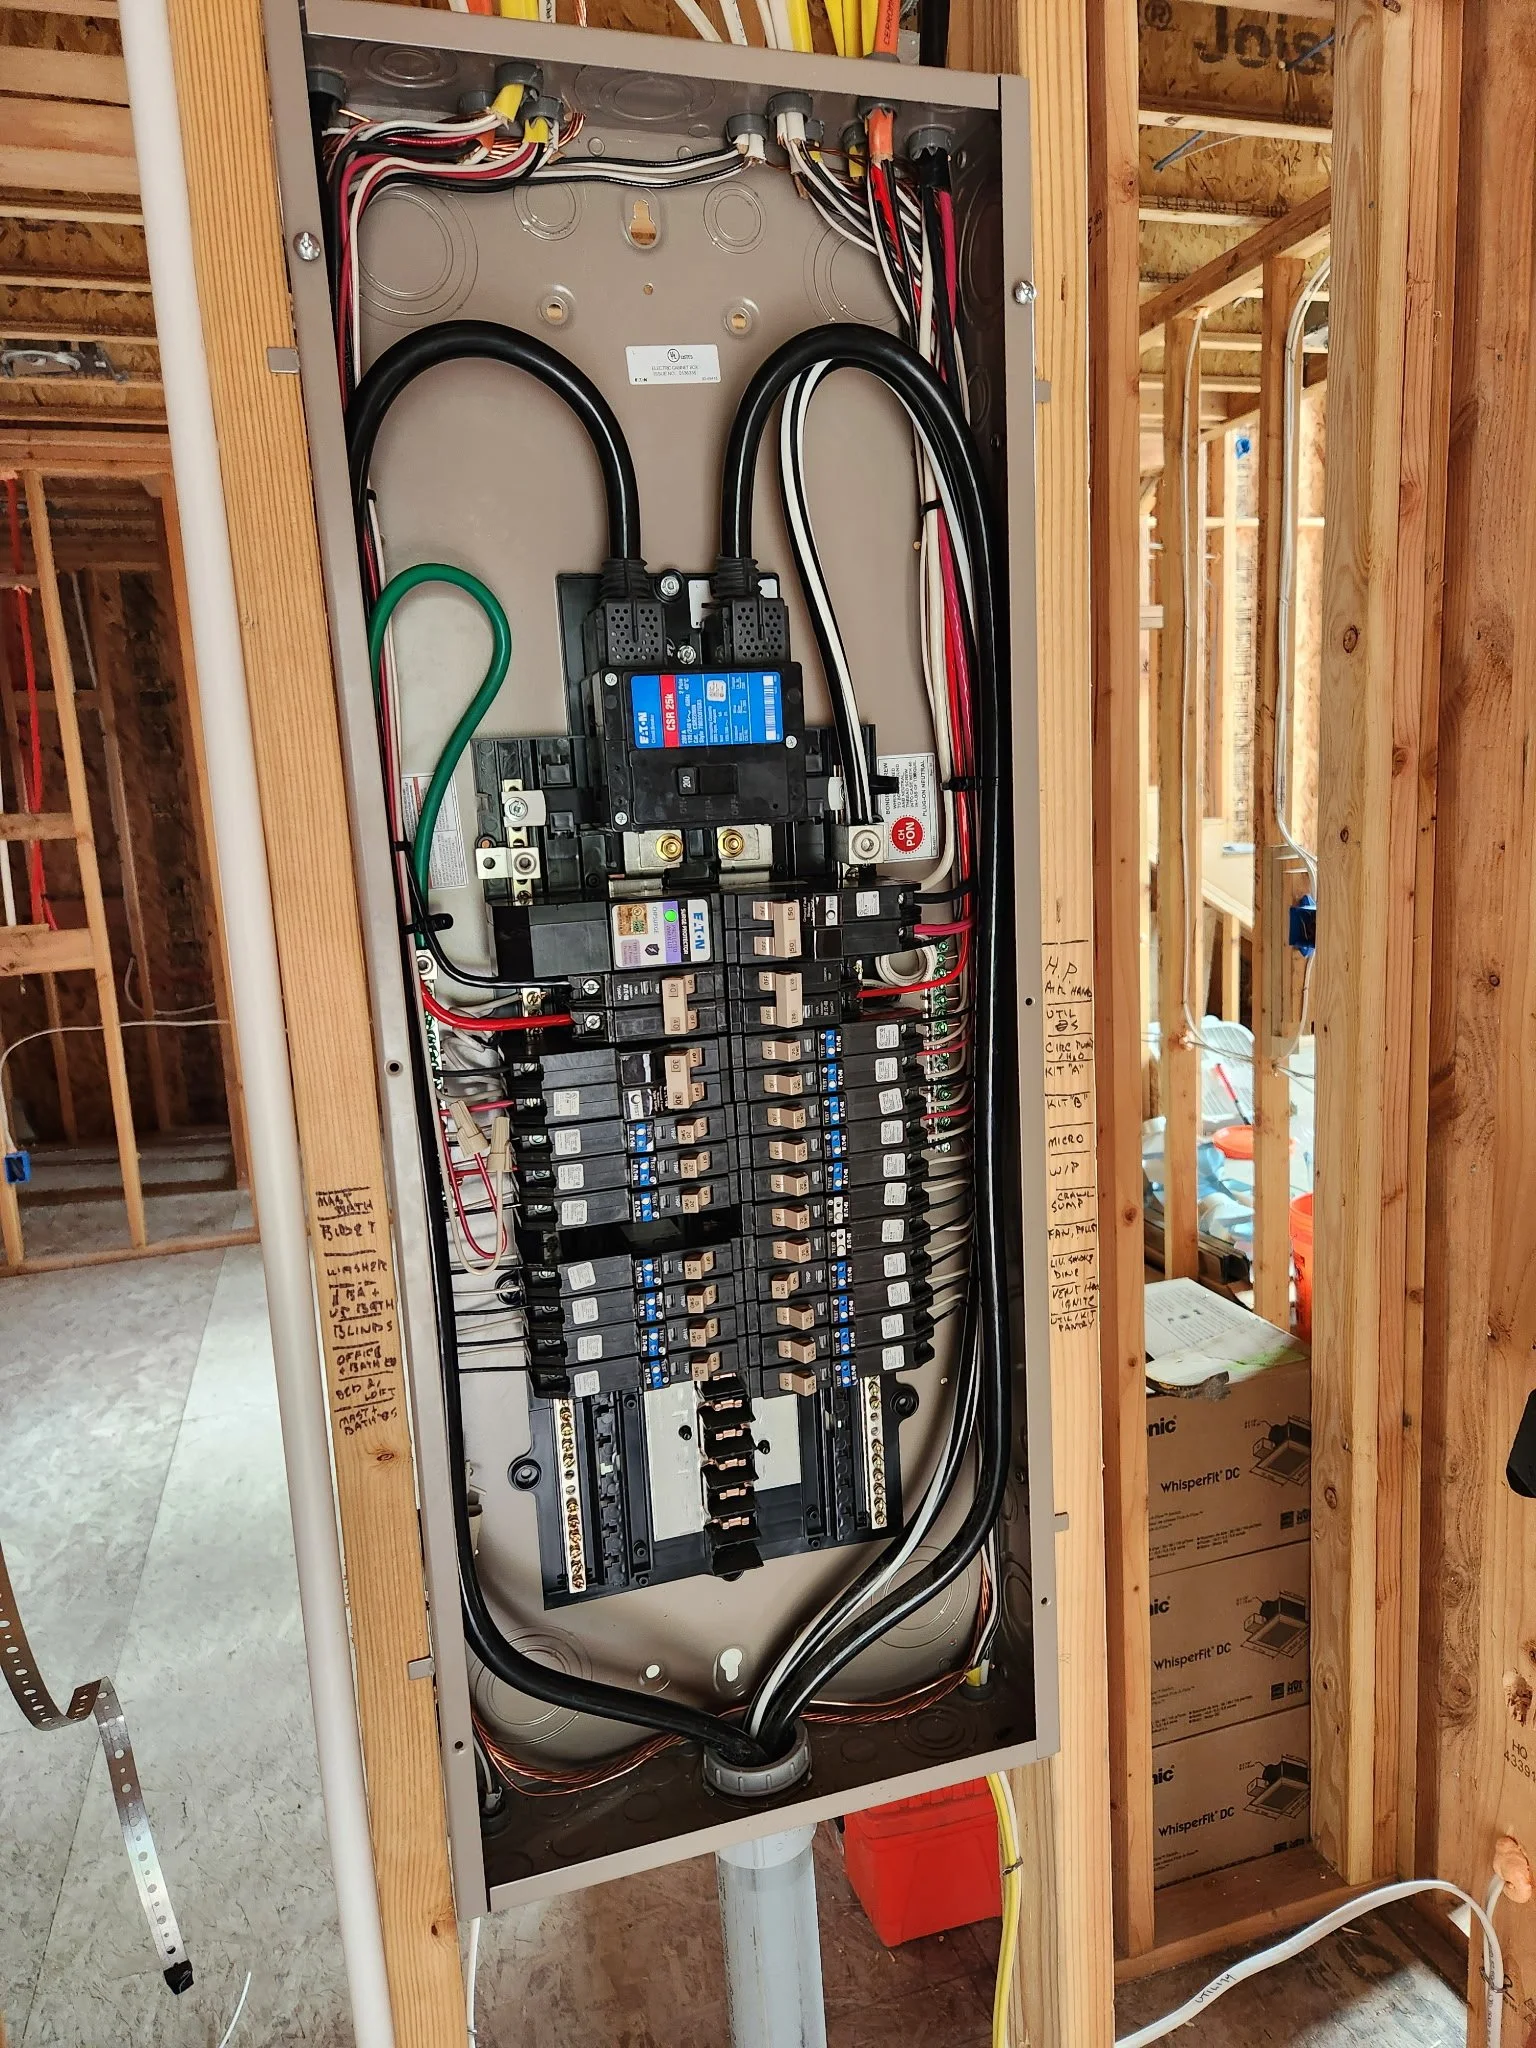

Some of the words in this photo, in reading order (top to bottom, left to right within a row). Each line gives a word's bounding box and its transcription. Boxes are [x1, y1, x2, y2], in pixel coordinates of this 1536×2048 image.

[665, 693, 675, 712] 25k
[666, 713, 676, 731] CSR
[897, 829, 905, 840] CH
[906, 821, 916, 847] PON
[693, 912, 705, 950] EATON
[1046, 1008, 1076, 1019] UTIL
[1045, 1041, 1072, 1053] CIRC
[1045, 1066, 1065, 1077] KIT
[1046, 1098, 1069, 1110] KIT
[1048, 1133, 1085, 1148] MICRO
[689, 1164, 694, 1172] 20
[1057, 1190, 1095, 1201] CRAWL
[690, 1200, 695, 1208] 20
[1051, 1199, 1084, 1213] SUMP
[319, 1220, 376, 1242] BIDET
[1052, 1284, 1081, 1299] VENT
[333, 1320, 394, 1339] BLINDS
[1058, 1318, 1095, 1332] PANTRY
[336, 1345, 382, 1366] OFFICE
[349, 1359, 380, 1373] BATH
[364, 1387, 396, 1401] LOFT
[1225, 1467, 1241, 1481] DC
[1216, 1642, 1232, 1656] DC
[1512, 1739, 1528, 1760] HO
[1219, 1806, 1235, 1820] DC
[1194, 1973, 1237, 2004] UTILITY
